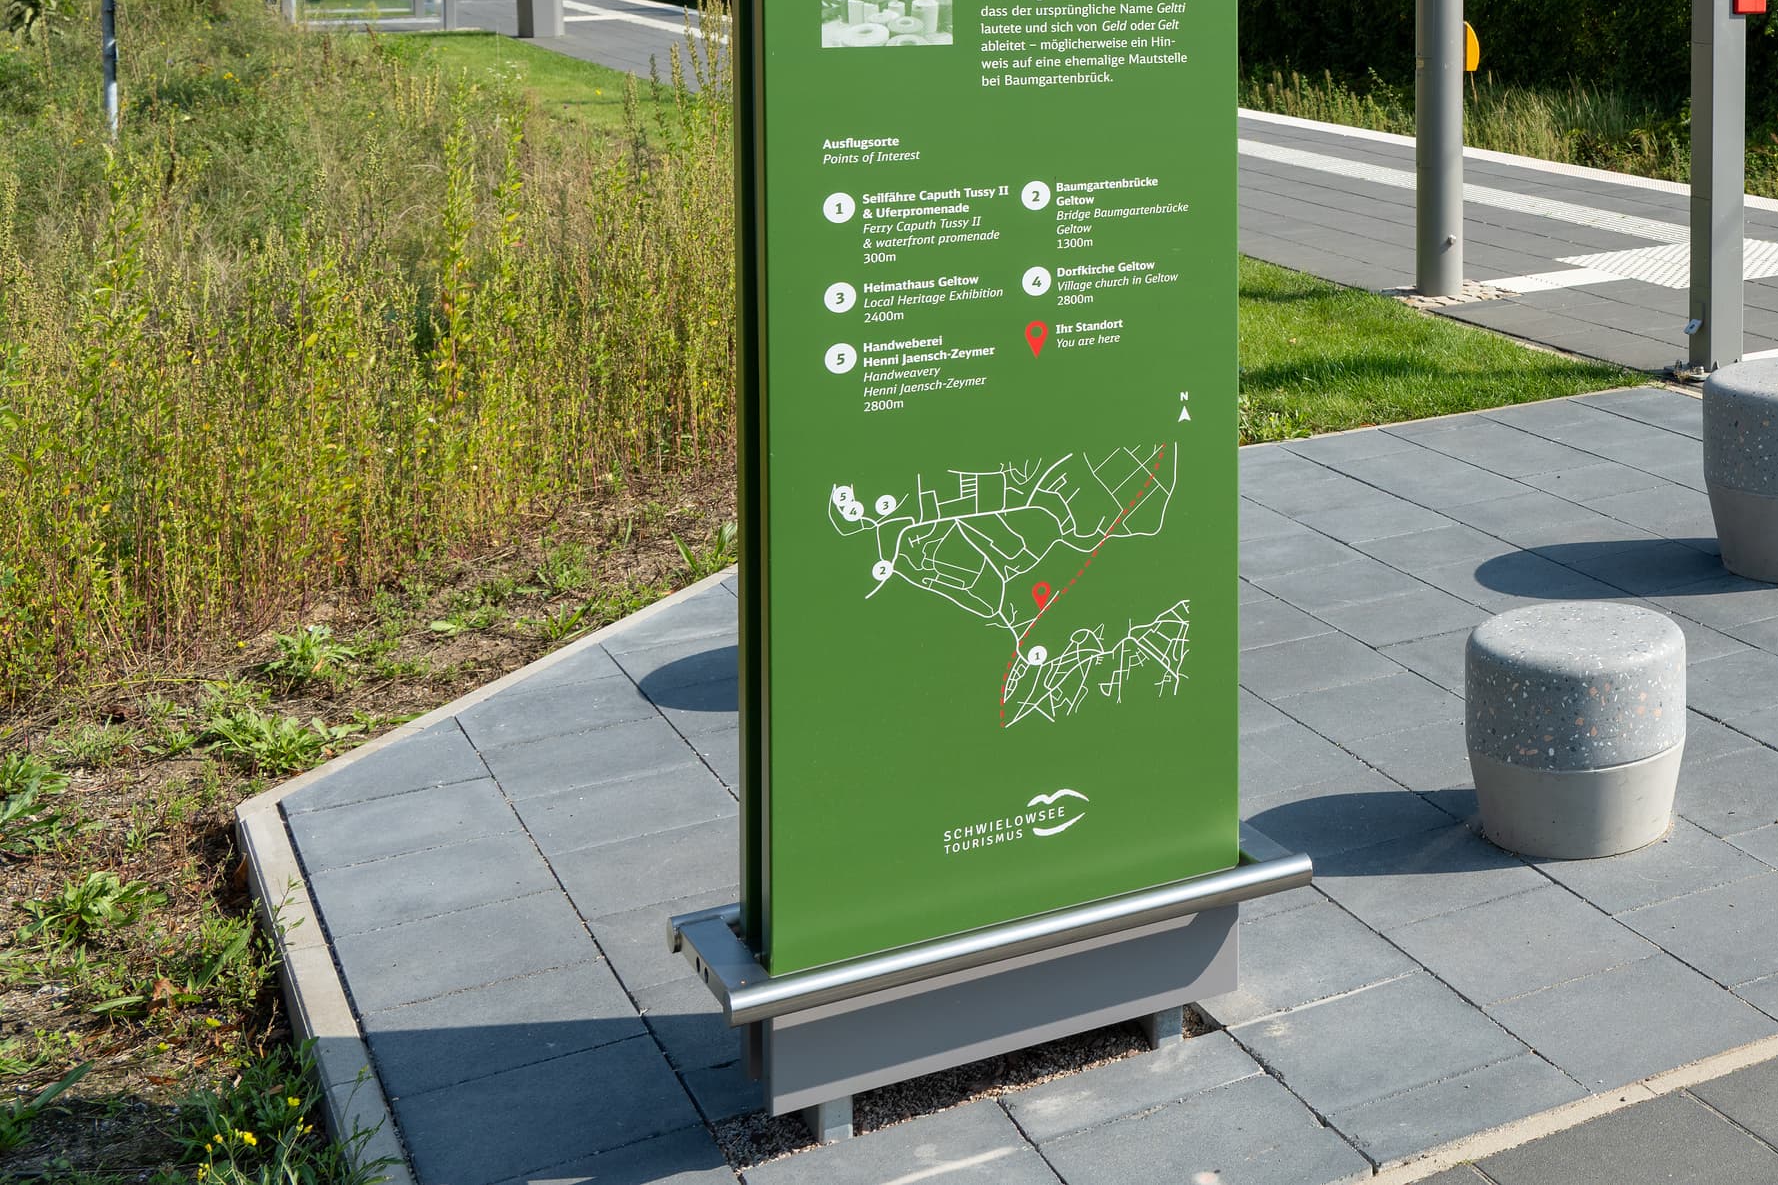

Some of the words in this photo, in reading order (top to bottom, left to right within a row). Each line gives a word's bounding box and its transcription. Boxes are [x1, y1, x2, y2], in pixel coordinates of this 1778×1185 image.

[982, 75, 1000, 86] bei
[1005, 71, 1113, 87] Baumgartenbrück.
[822, 137, 900, 150] Ausflugsorte
[823, 154, 859, 164] Points
[862, 152, 875, 164] of
[876, 151, 920, 161] Interest
[1056, 177, 1158, 192] Baumgartenbrücke
[863, 192, 916, 204] Seilfähre
[919, 188, 960, 202] Caputh
[963, 188, 996, 198] Tussy
[998, 185, 1009, 196] II
[1056, 195, 1094, 206] Geltow
[863, 209, 873, 219] &
[876, 203, 969, 218] Uferpromenade
[1056, 210, 1091, 221] Bridge
[1094, 203, 1189, 218] Baumgartenbrücke
[863, 224, 893, 234] Ferry
[896, 219, 936, 233] Caputh
[940, 219, 969, 229] Tussy
[971, 216, 981, 226] II
[1057, 224, 1092, 235] Geltow
[863, 238, 872, 248] &
[876, 235, 935, 248] waterfront
[938, 230, 1000, 246] promenade
[1057, 238, 1093, 249] 1300m
[864, 252, 896, 264] 300m
[1057, 264, 1115, 277] Dorfkirche
[1118, 261, 1155, 272] Geltow
[864, 280, 935, 293] Heimathaus
[938, 276, 979, 287] Geltow
[1058, 281, 1092, 292] Village
[1095, 276, 1129, 288] church
[1132, 276, 1142, 285] in
[1145, 273, 1178, 284] Geltow
[864, 296, 894, 308] Local
[897, 294, 946, 305] Heritage
[949, 288, 1003, 301] Exhibition
[1057, 294, 1093, 305] 2800m
[864, 311, 904, 323] 2400m
[1056, 324, 1073, 334] Ihr
[1076, 319, 1123, 332] Standort
[863, 335, 942, 352] Handweberei
[1057, 338, 1075, 348] You
[1078, 337, 1095, 346] are
[1098, 334, 1120, 343] here
[864, 354, 899, 367] Henni
[902, 347, 995, 366] Jaensch-Zeymer
[864, 367, 941, 382] Handweavery
[864, 384, 897, 397] Henni
[899, 377, 987, 396] Jaensch-Zeymer
[1180, 391, 1188, 401] N
[864, 399, 904, 412] 2800m
[943, 806, 1065, 842] SCHWIELOWSEE
[944, 828, 1023, 855] TOURISMUS
